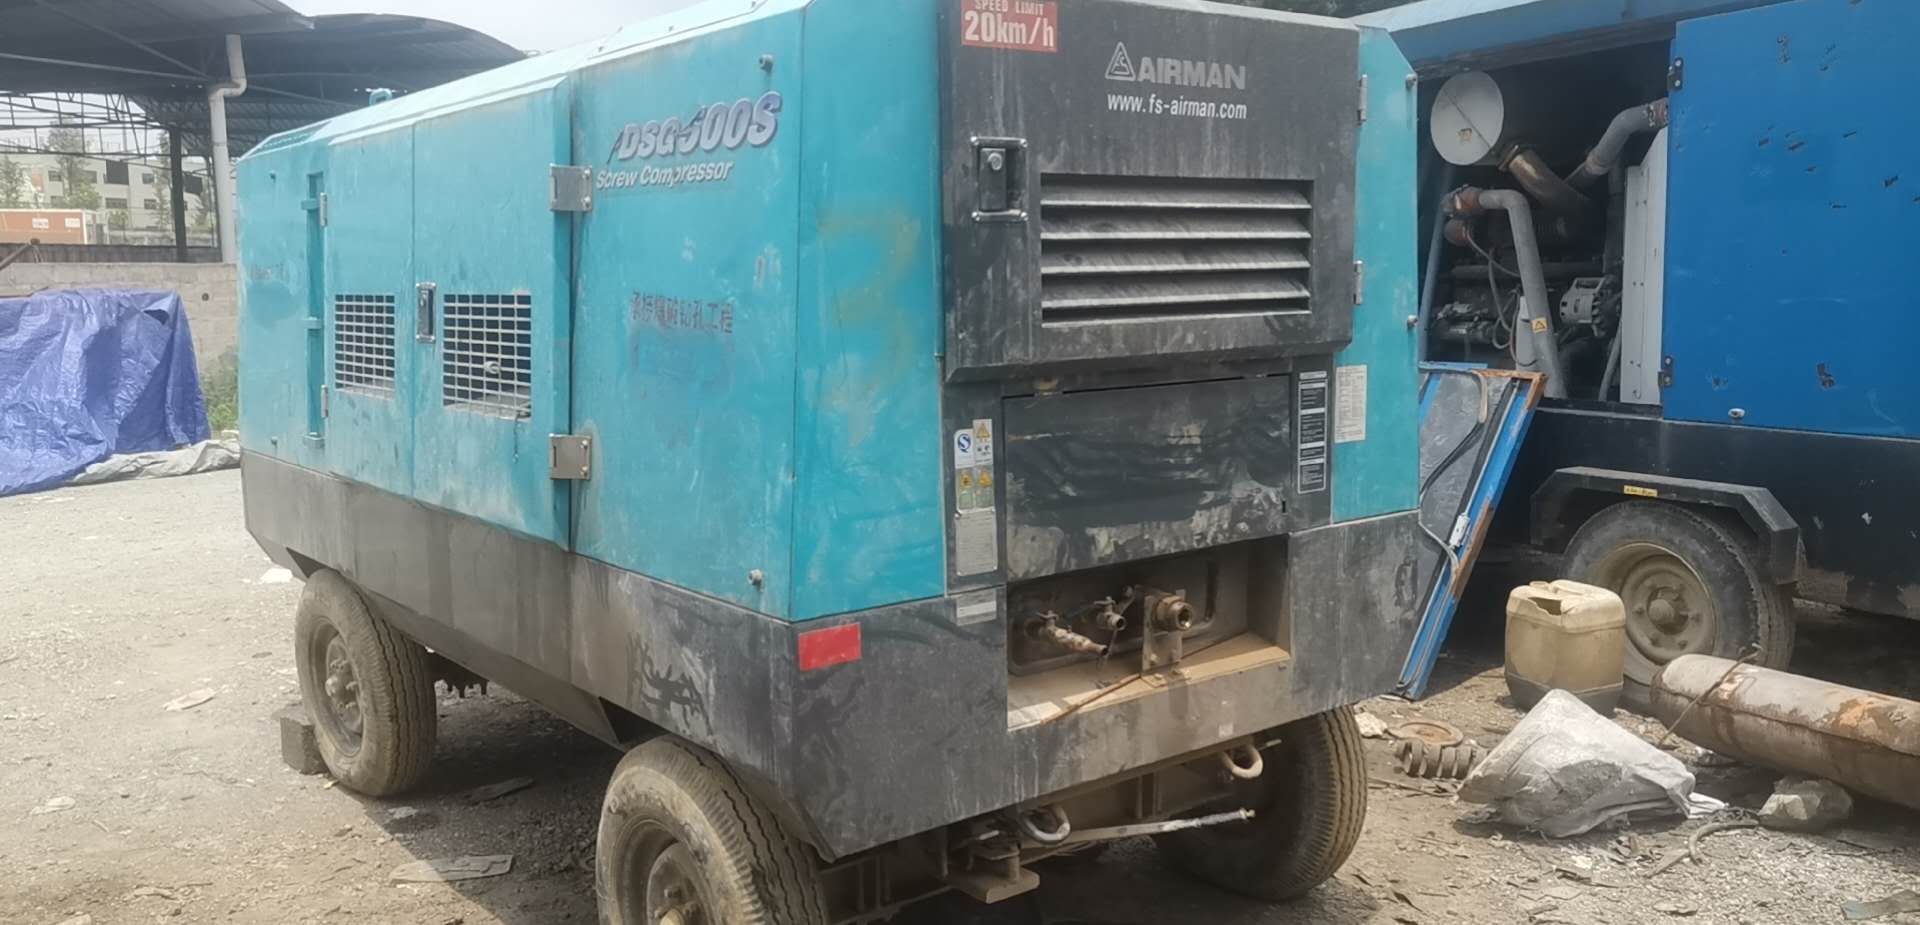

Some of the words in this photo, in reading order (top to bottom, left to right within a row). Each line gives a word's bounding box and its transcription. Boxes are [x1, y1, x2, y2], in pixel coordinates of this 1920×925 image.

[975, 0, 1009, 12] SPEED
[1015, 1, 1044, 16] LIMIT
[964, 10, 1054, 48] 20km/h
[1137, 56, 1246, 90] AIRMAN
[1107, 93, 1247, 119] www.fs-airman.com
[596, 169, 637, 190] Screw
[640, 162, 733, 187] Compressor
